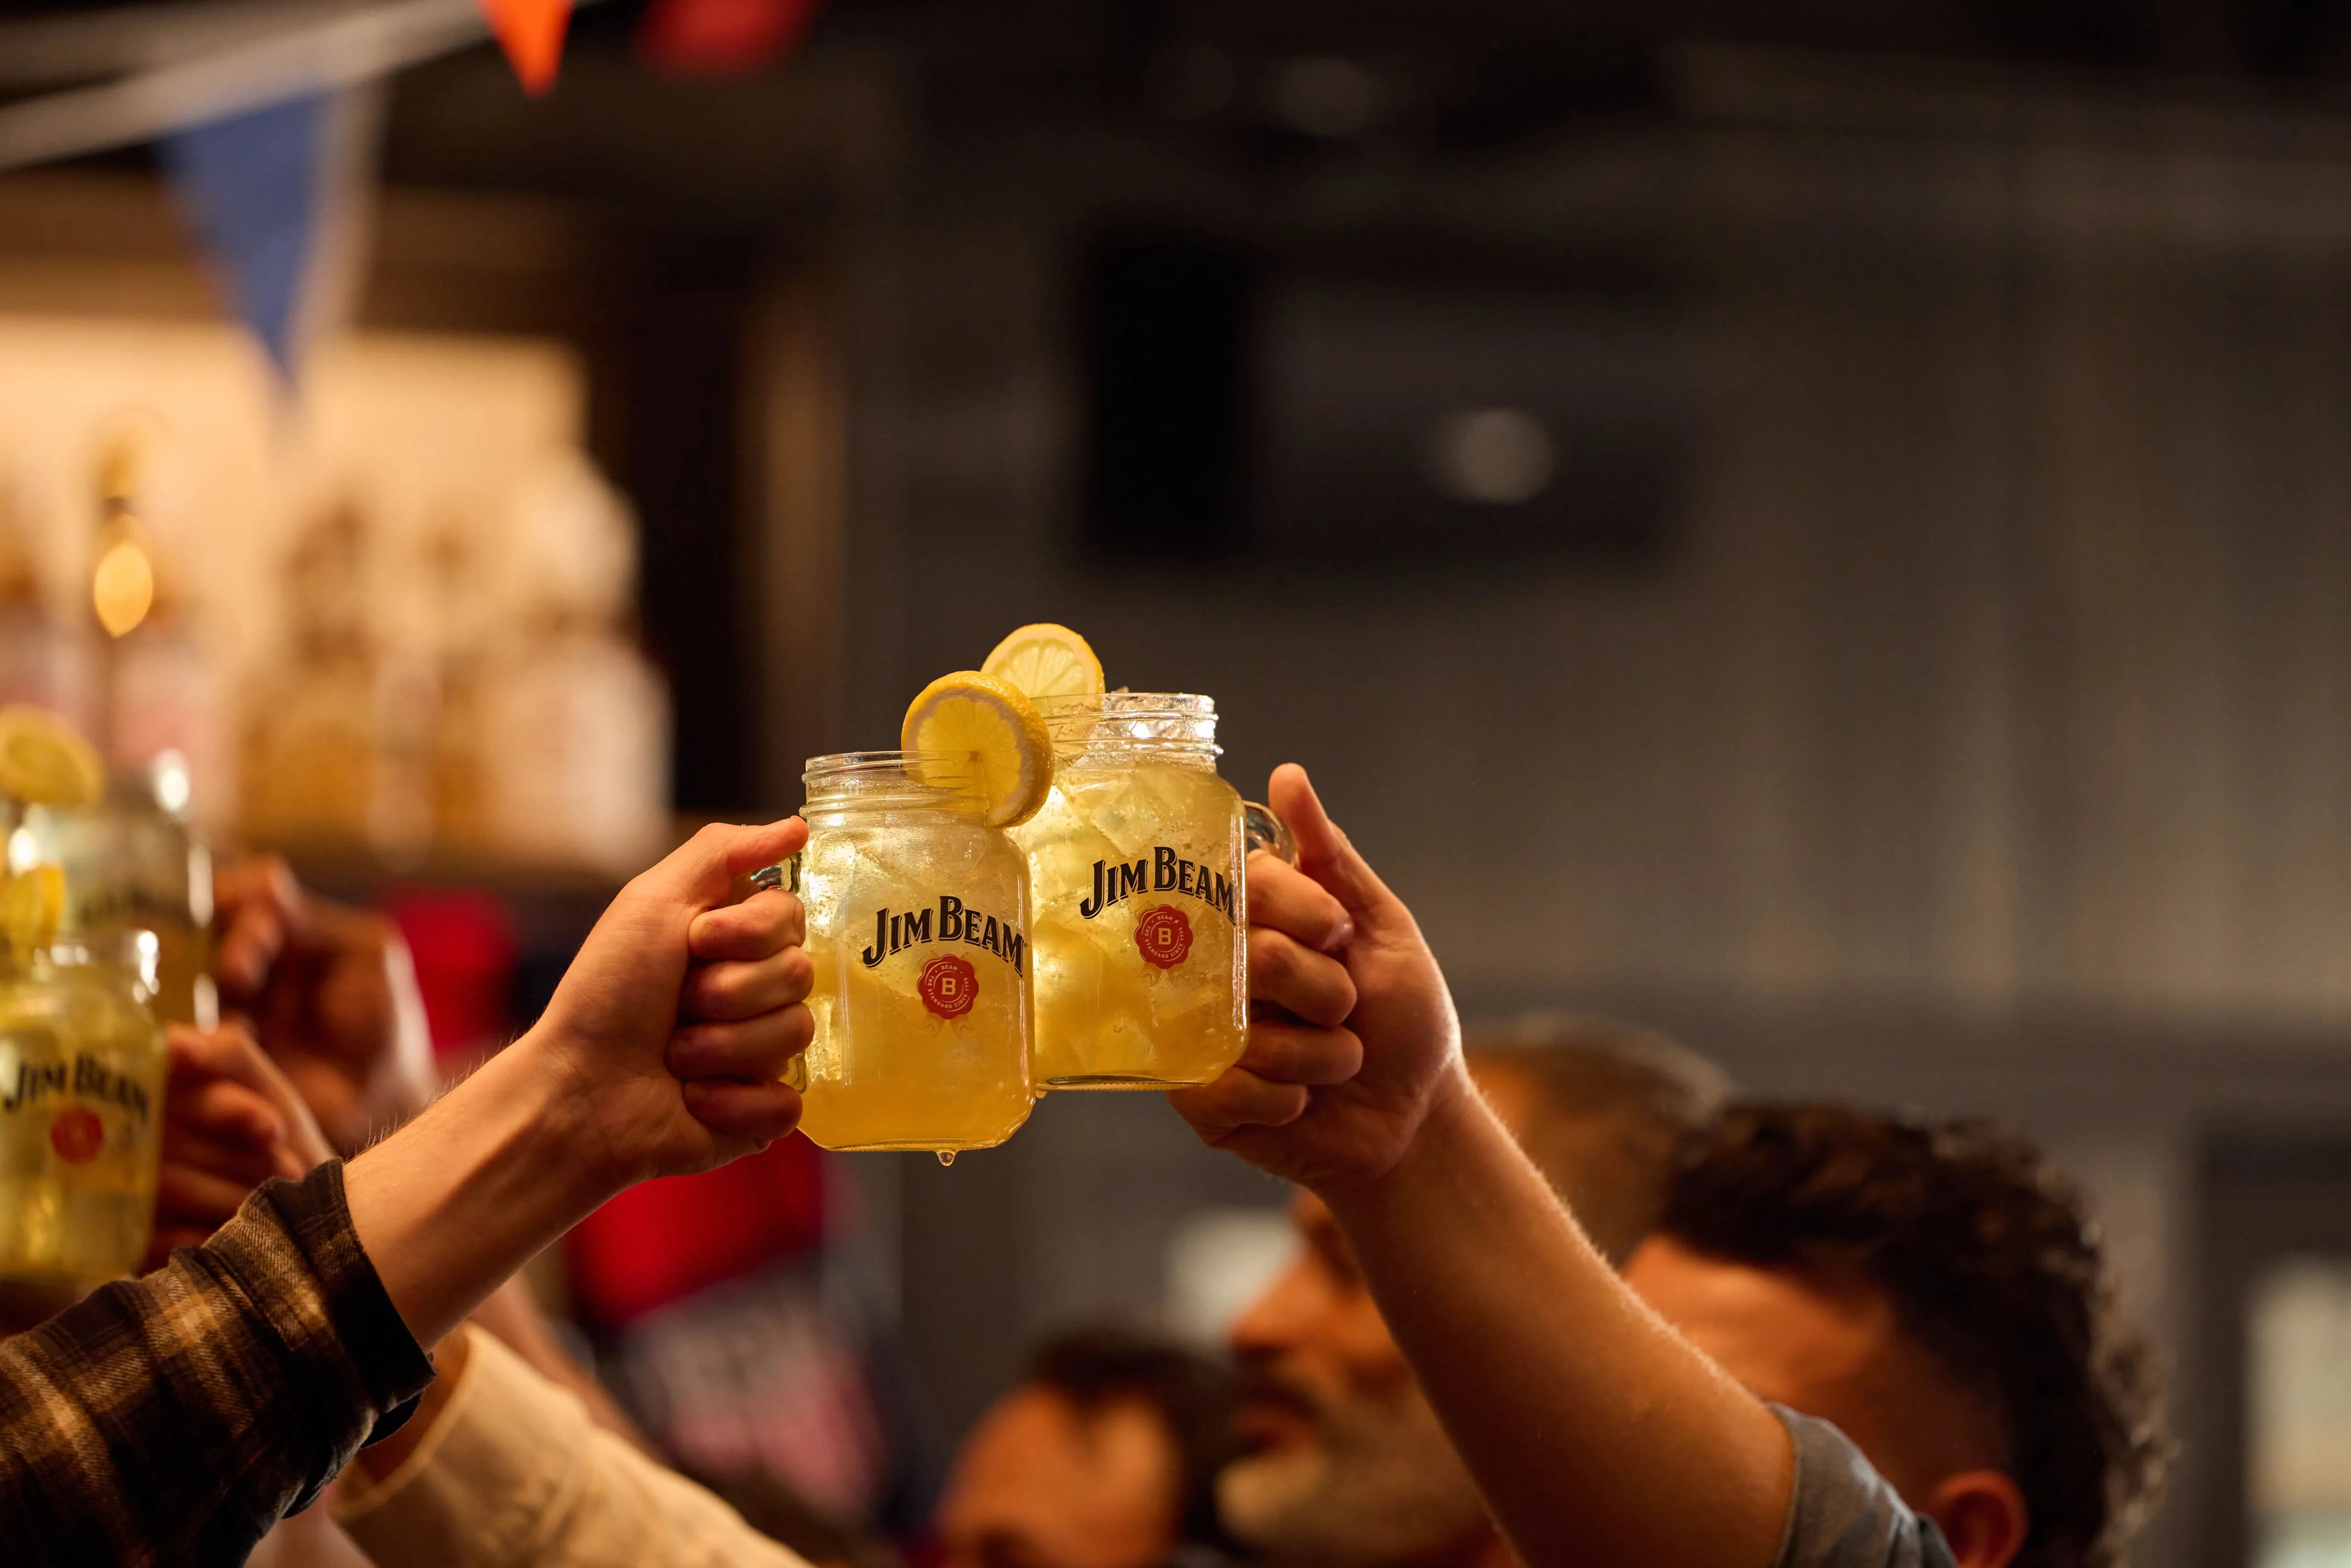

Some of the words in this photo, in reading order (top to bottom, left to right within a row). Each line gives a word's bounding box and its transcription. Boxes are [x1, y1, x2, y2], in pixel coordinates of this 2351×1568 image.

[1079, 859, 1149, 920] JIM
[1153, 846, 1236, 926] BEAM
[862, 907, 934, 968] JIM
[938, 895, 1024, 978] BEAM
[1158, 927, 1171, 945] B
[1145, 939, 1169, 959] STANDARD
[1170, 943, 1183, 957] SINCE
[941, 978, 956, 995] B
[928, 988, 953, 1009] STANDARD
[954, 993, 968, 1008] SINCE
